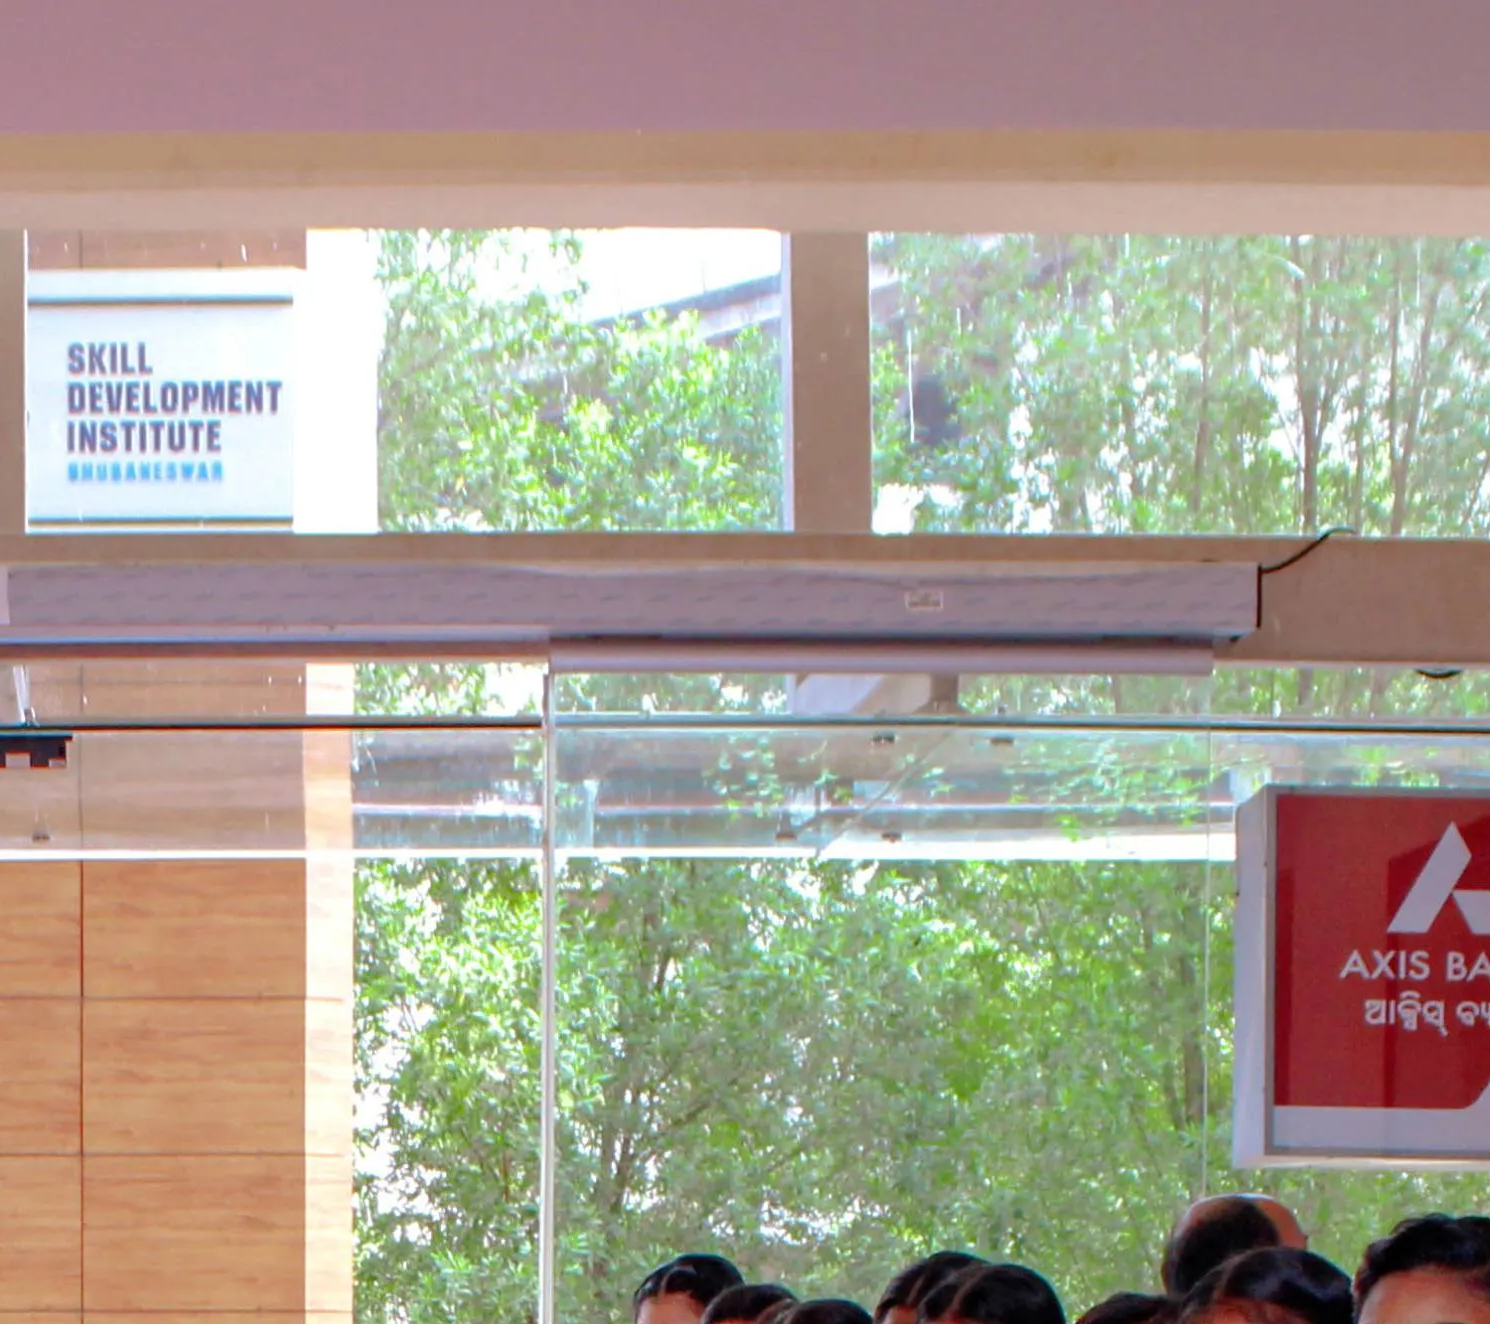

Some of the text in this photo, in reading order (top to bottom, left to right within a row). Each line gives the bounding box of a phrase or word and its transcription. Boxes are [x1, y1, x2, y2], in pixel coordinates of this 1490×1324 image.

[67, 341, 153, 376] SKILL
[67, 379, 283, 415] DEVELOPMENT
[66, 419, 222, 454] INSTITUTE
[67, 460, 224, 483] BHUBANESWAR
[1339, 949, 1431, 981] AXIS
